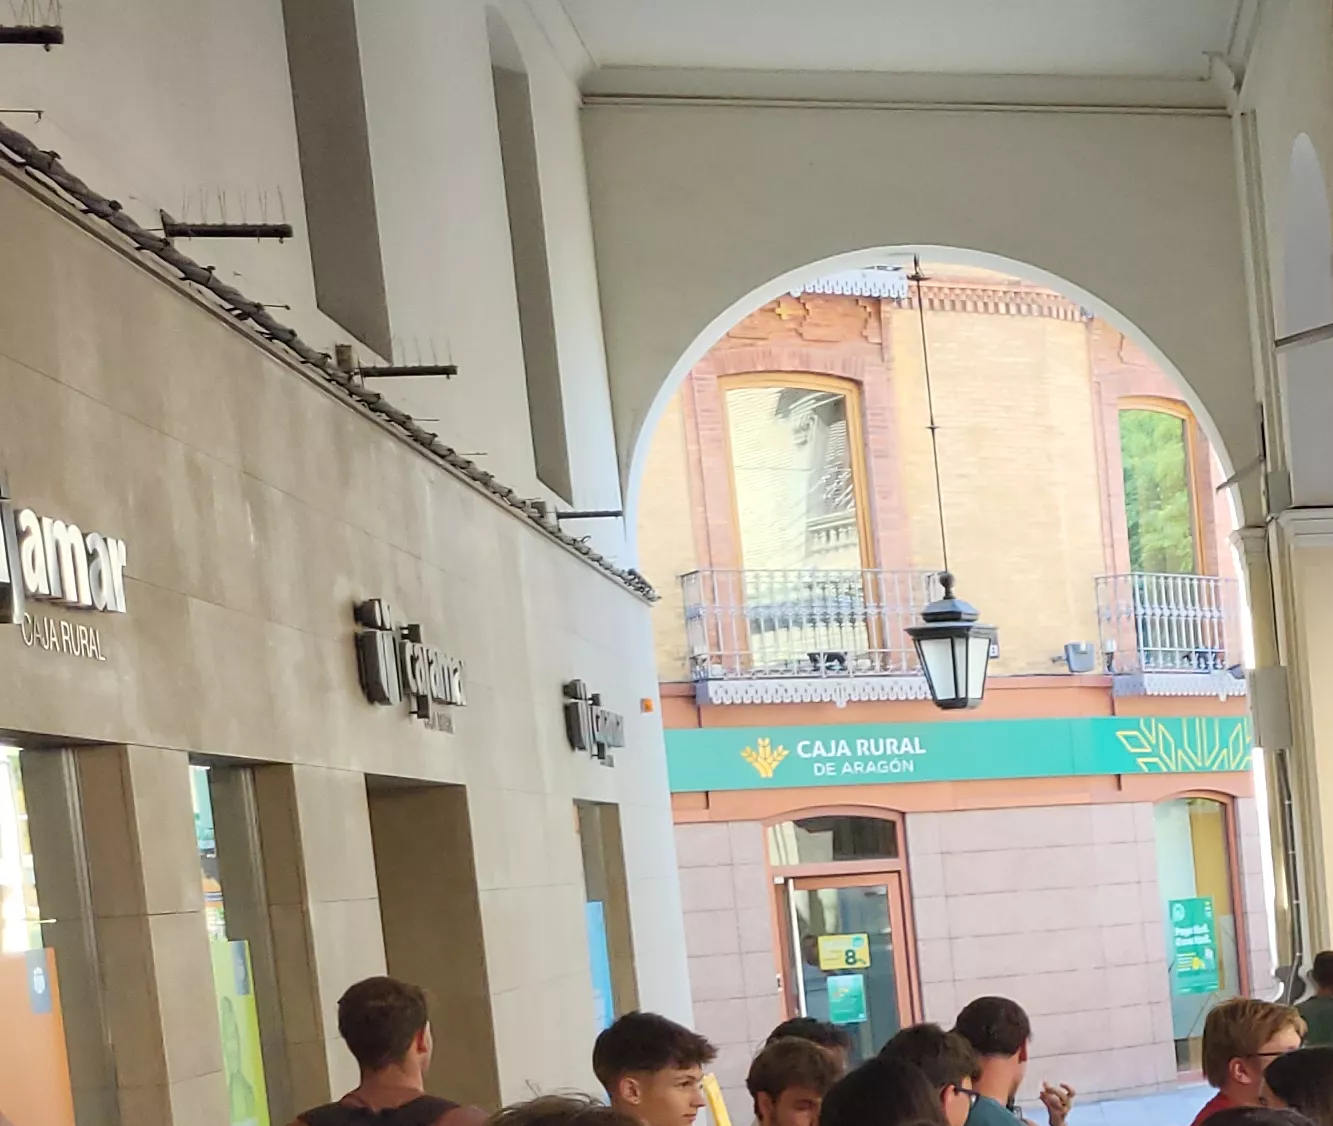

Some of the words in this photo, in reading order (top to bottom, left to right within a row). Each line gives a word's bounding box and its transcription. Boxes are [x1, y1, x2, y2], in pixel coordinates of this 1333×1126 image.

[21, 612, 60, 652] CAJA
[60, 620, 106, 661] RURAL
[796, 739, 852, 758] CAJA
[856, 736, 927, 756] RURAL
[813, 762, 836, 776] DE
[840, 758, 914, 775] ARAGÓN
